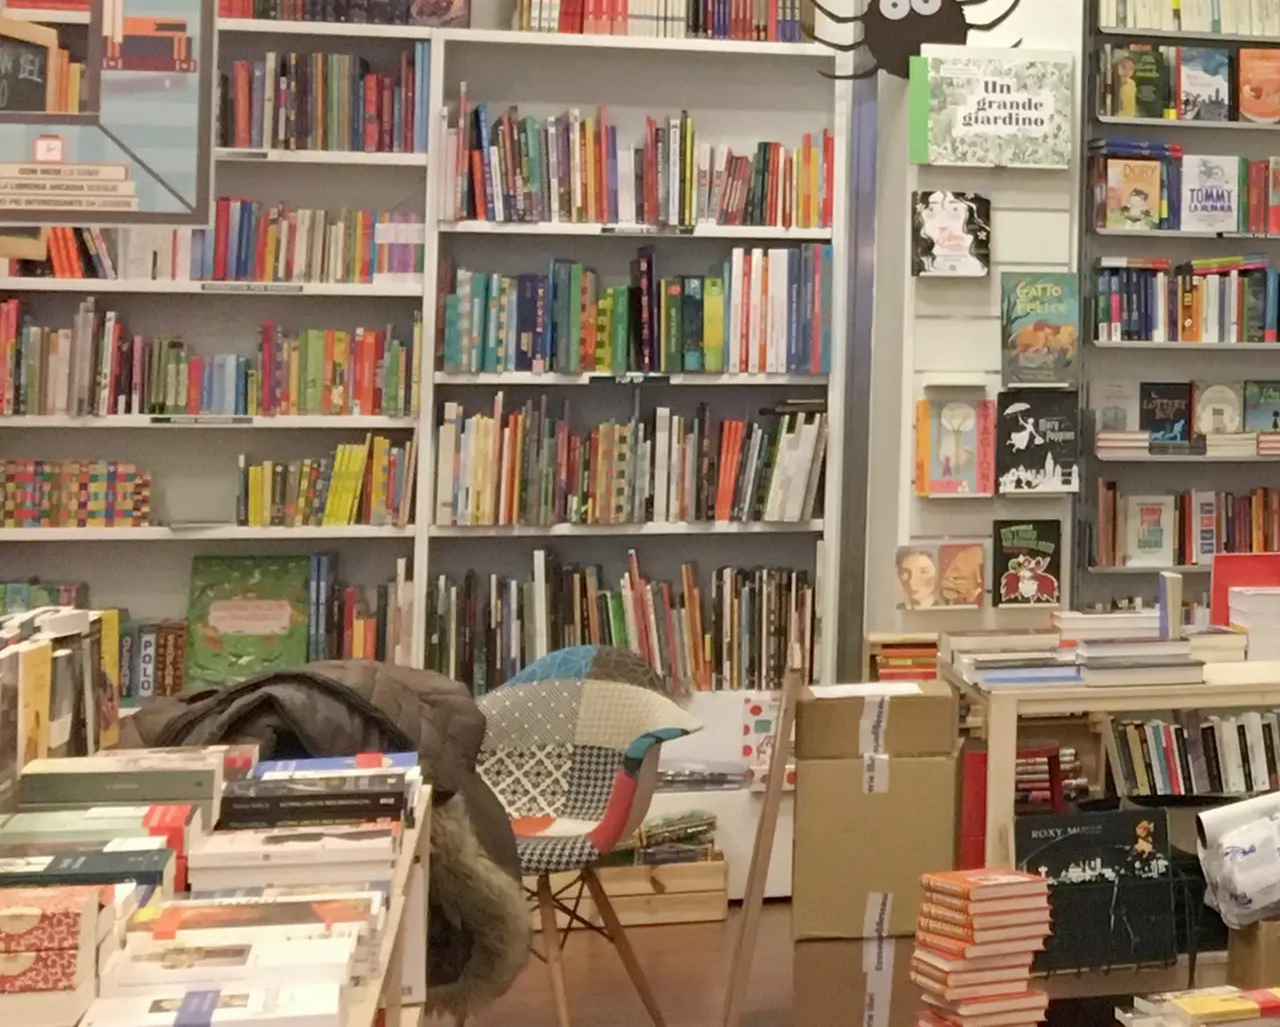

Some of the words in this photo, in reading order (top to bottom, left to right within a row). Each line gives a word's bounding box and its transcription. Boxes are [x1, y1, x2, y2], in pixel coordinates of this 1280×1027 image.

[983, 80, 1012, 95] Un
[976, 97, 1044, 112] grande
[962, 111, 1045, 127] giardino
[1189, 188, 1233, 204] TOMMY
[142, 639, 155, 691] POLO
[1031, 828, 1064, 839] ROXY
